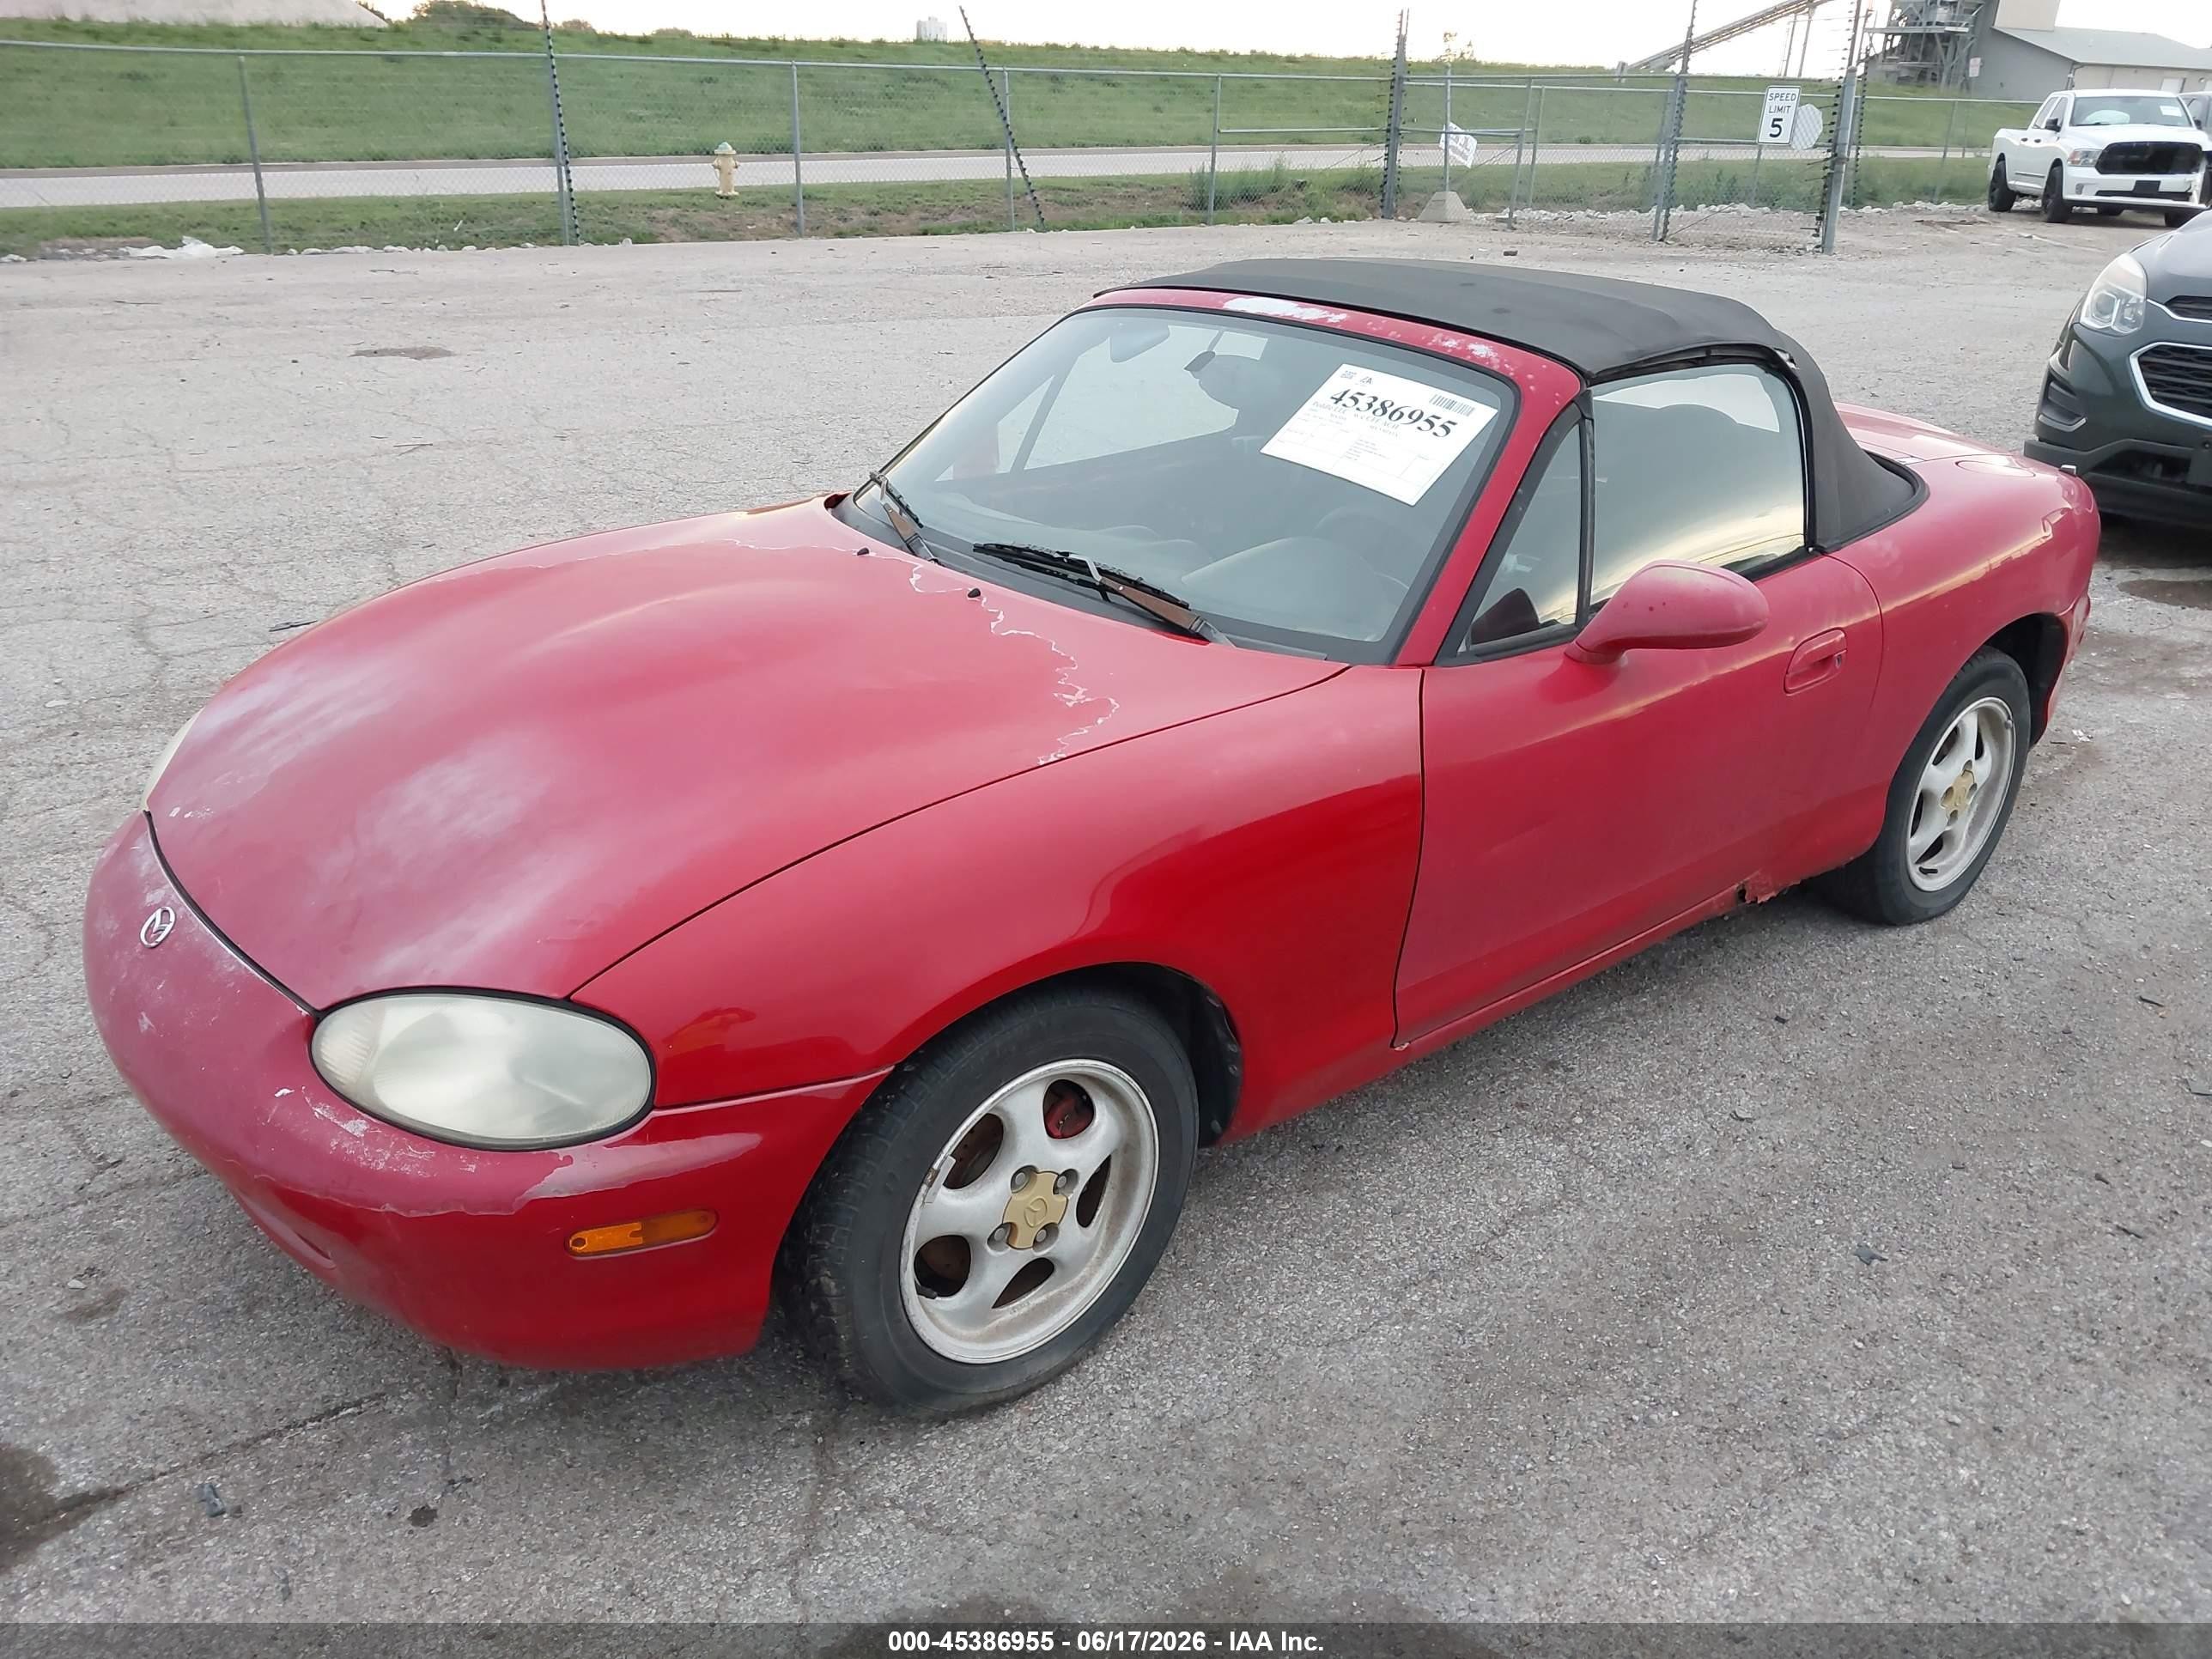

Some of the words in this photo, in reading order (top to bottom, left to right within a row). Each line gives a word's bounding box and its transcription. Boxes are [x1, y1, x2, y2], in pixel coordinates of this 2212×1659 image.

[1768, 93, 1796, 101] SPEED
[1769, 118, 1784, 137] 5
[1330, 389, 1457, 438] 45386955
